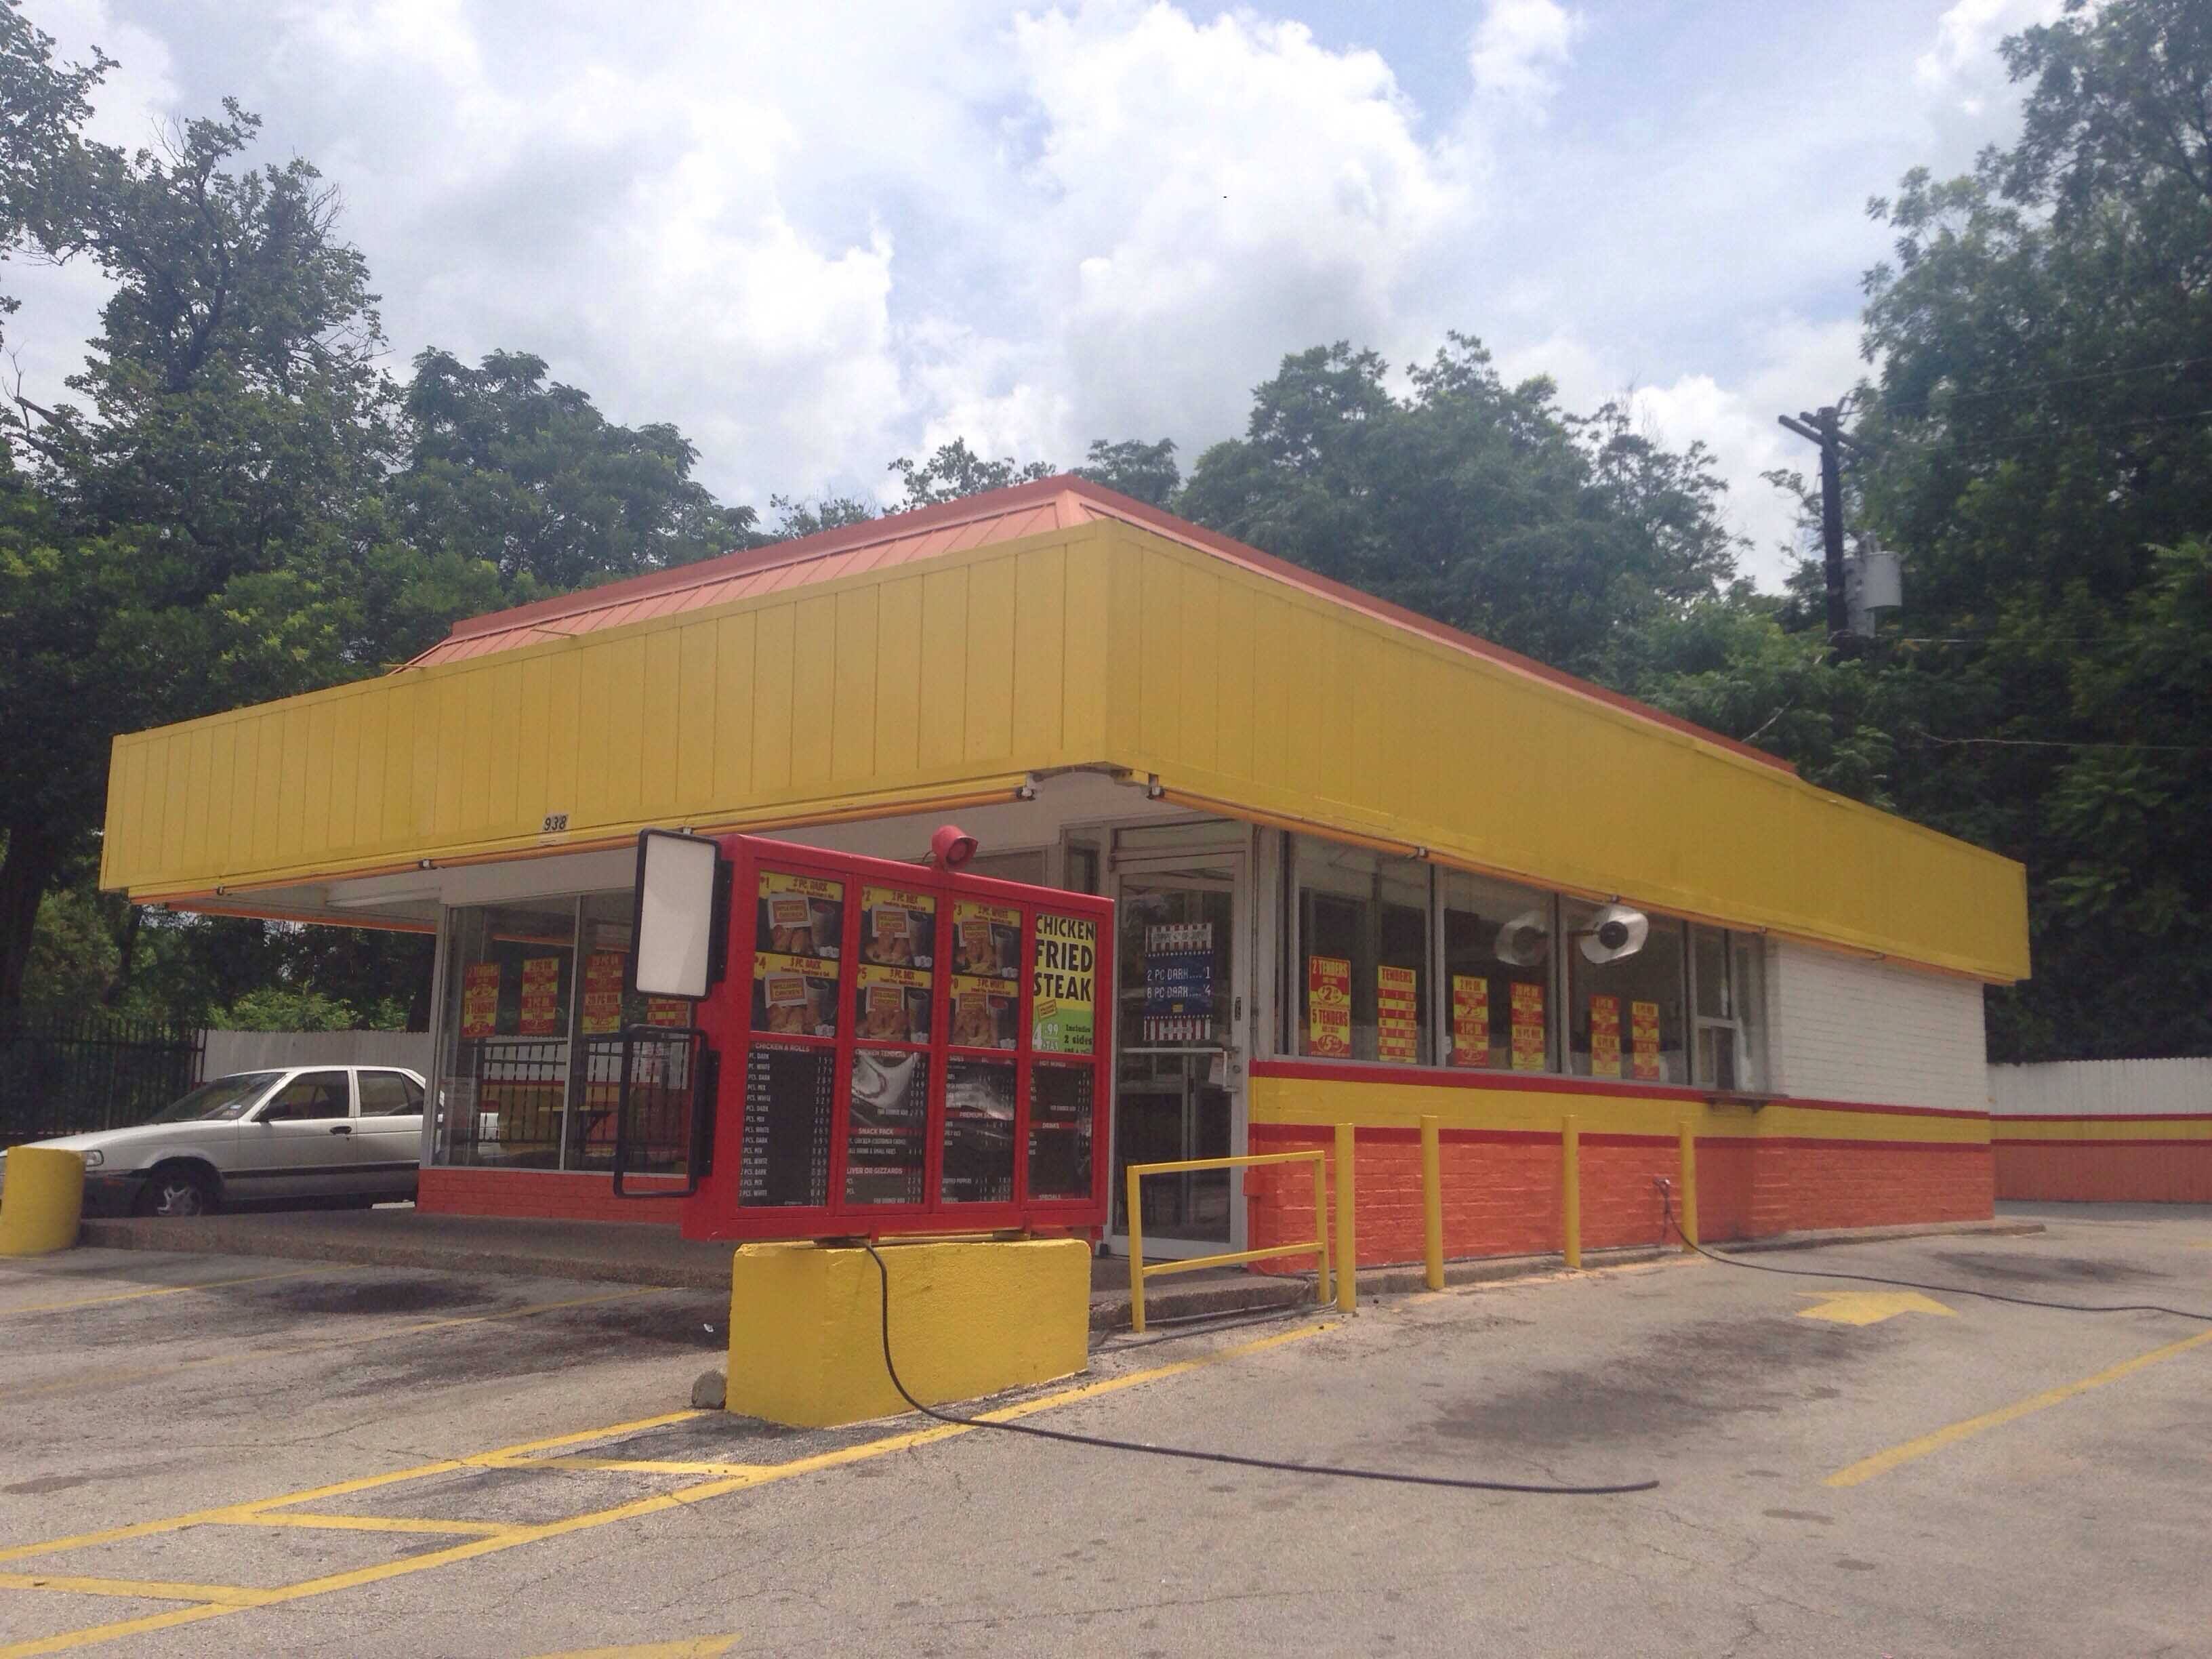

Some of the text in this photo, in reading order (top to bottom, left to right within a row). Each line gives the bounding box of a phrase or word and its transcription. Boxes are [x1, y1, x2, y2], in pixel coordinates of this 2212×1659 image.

[544, 815, 567, 831] 938
[1035, 914, 1094, 941] CHICKEN
[1035, 939, 1092, 972] FRIED
[1147, 970, 1153, 981] 2
[1155, 968, 1165, 981] PC
[1313, 959, 1348, 979] 2 TENDERS
[1382, 968, 1413, 983] TENDERS
[1033, 972, 1091, 1002] STEAK
[1155, 987, 1165, 998] PC
[1312, 1008, 1348, 1027] 5 TENDERS
[755, 1042, 783, 1050] CHICKEN
[1064, 1035, 1092, 1046] 2 sides
[858, 1127, 894, 1136] SNACK PACK
[846, 1166, 863, 1174] LIVER
[874, 1167, 903, 1175] GIZZARDS
